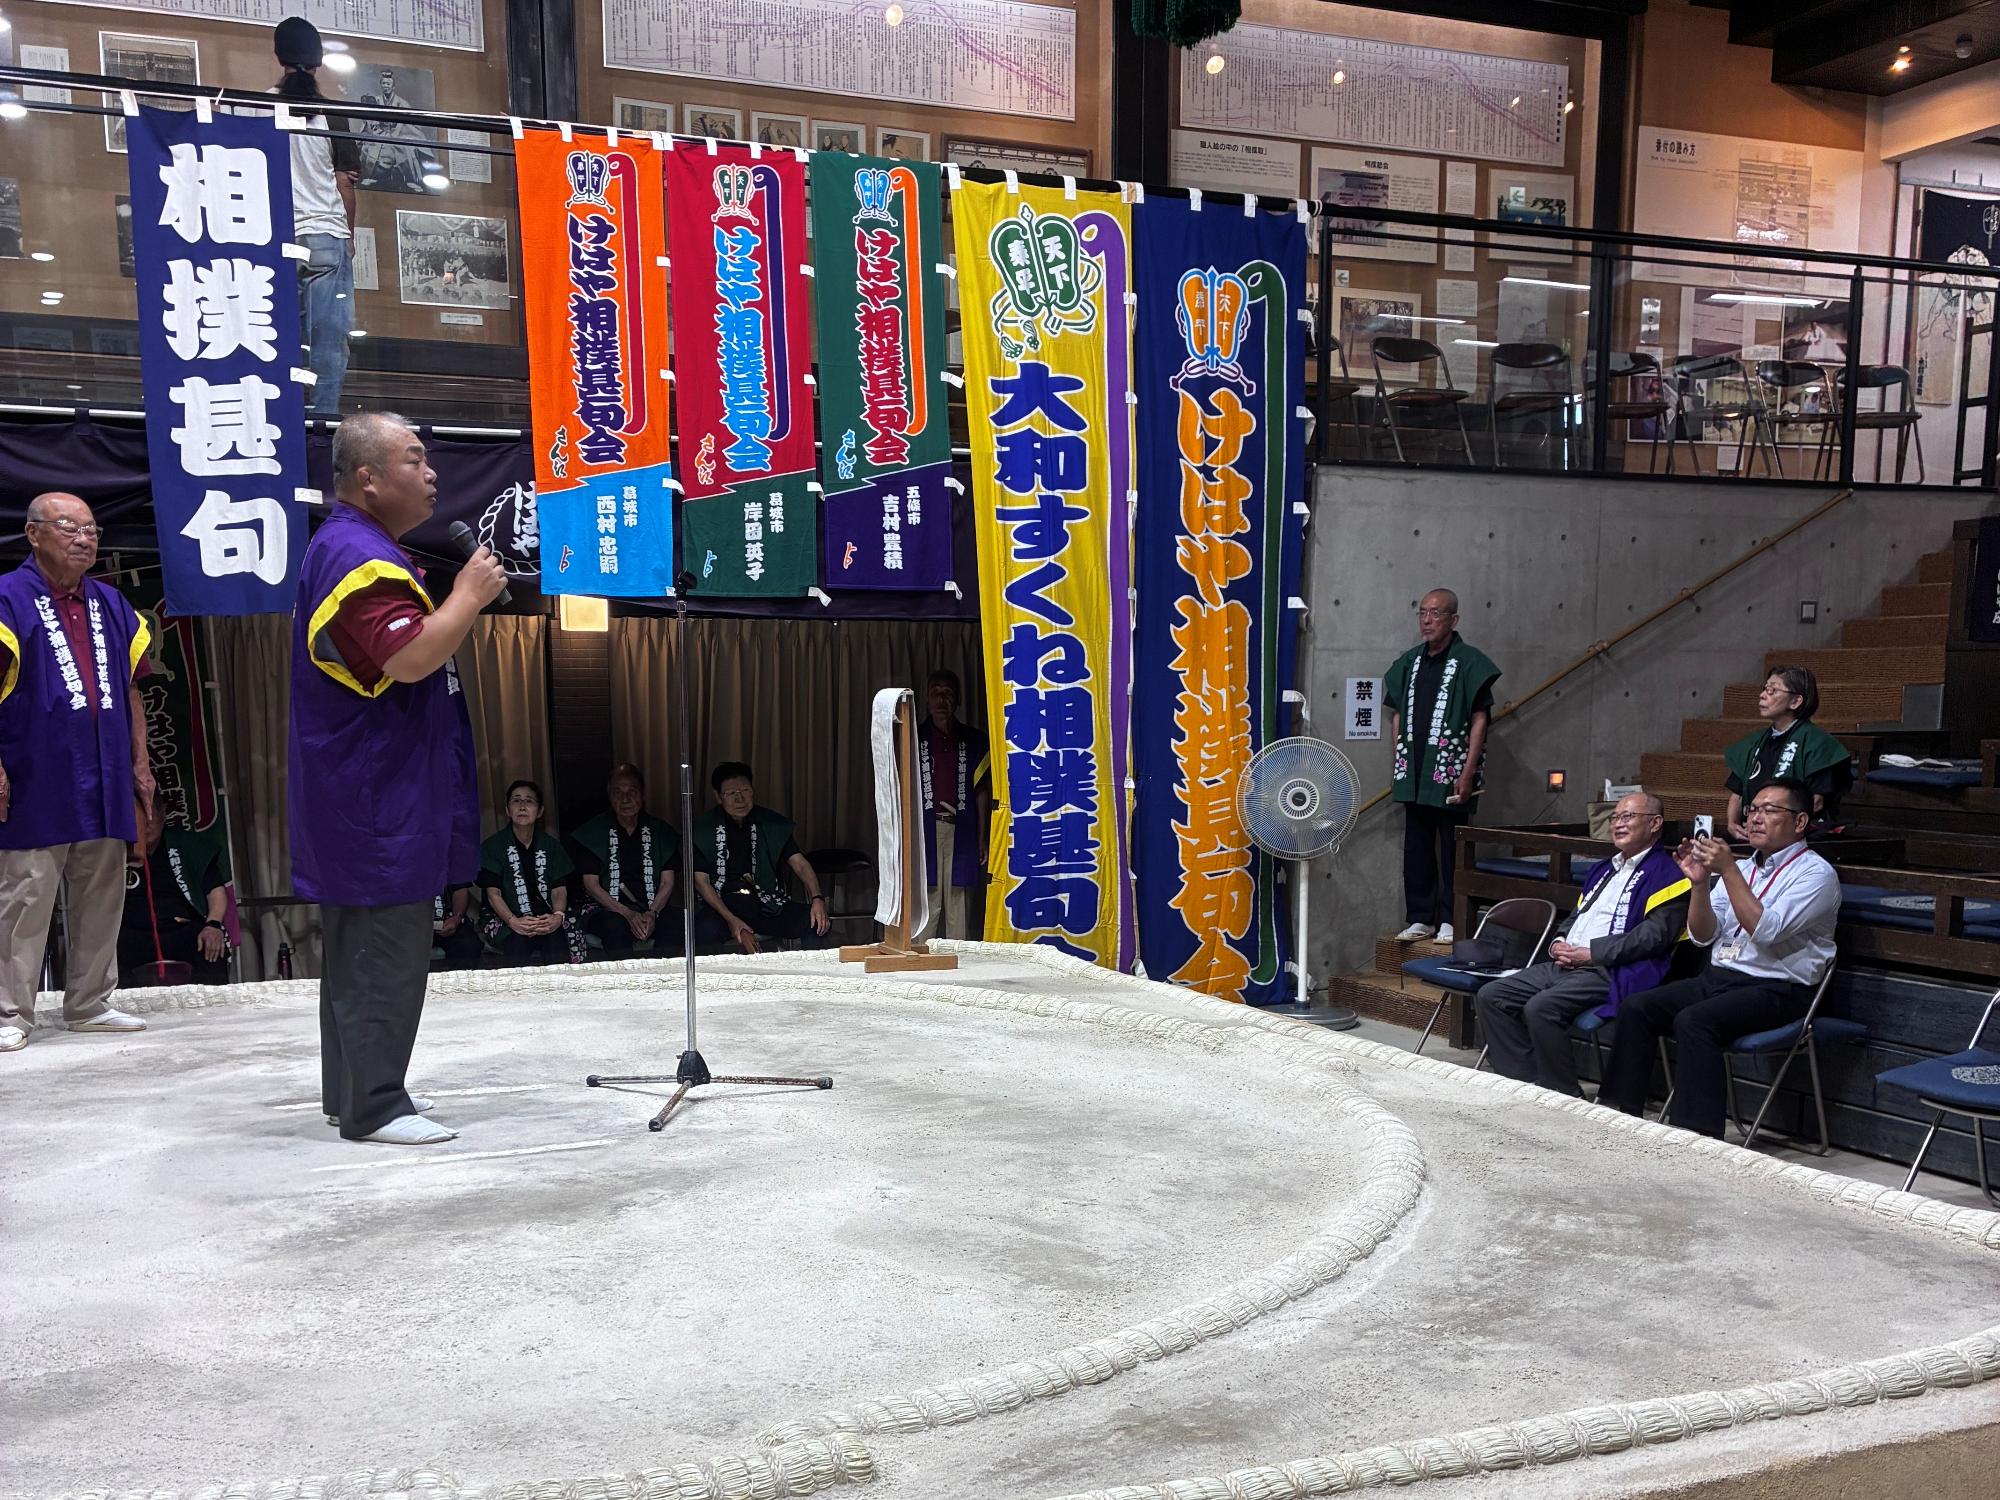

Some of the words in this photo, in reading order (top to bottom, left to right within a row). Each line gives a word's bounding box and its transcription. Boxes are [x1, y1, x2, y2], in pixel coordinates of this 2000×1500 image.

[1007, 238, 1036, 296] 泰平
[1041, 234, 1071, 291] 天下
[567, 211, 628, 466] けはや相撲甚句会
[1217, 292, 1231, 340] 天下
[158, 142, 288, 586] 相撲甚句
[713, 224, 773, 473] けはや相撲甚句会
[854, 226, 911, 466] けはや相撲甚句会
[622, 485, 638, 528] 葛城市
[768, 492, 784, 534] 葛城市
[744, 501, 765, 581] 岸田英子
[1355, 680, 1374, 728] 禁煙
